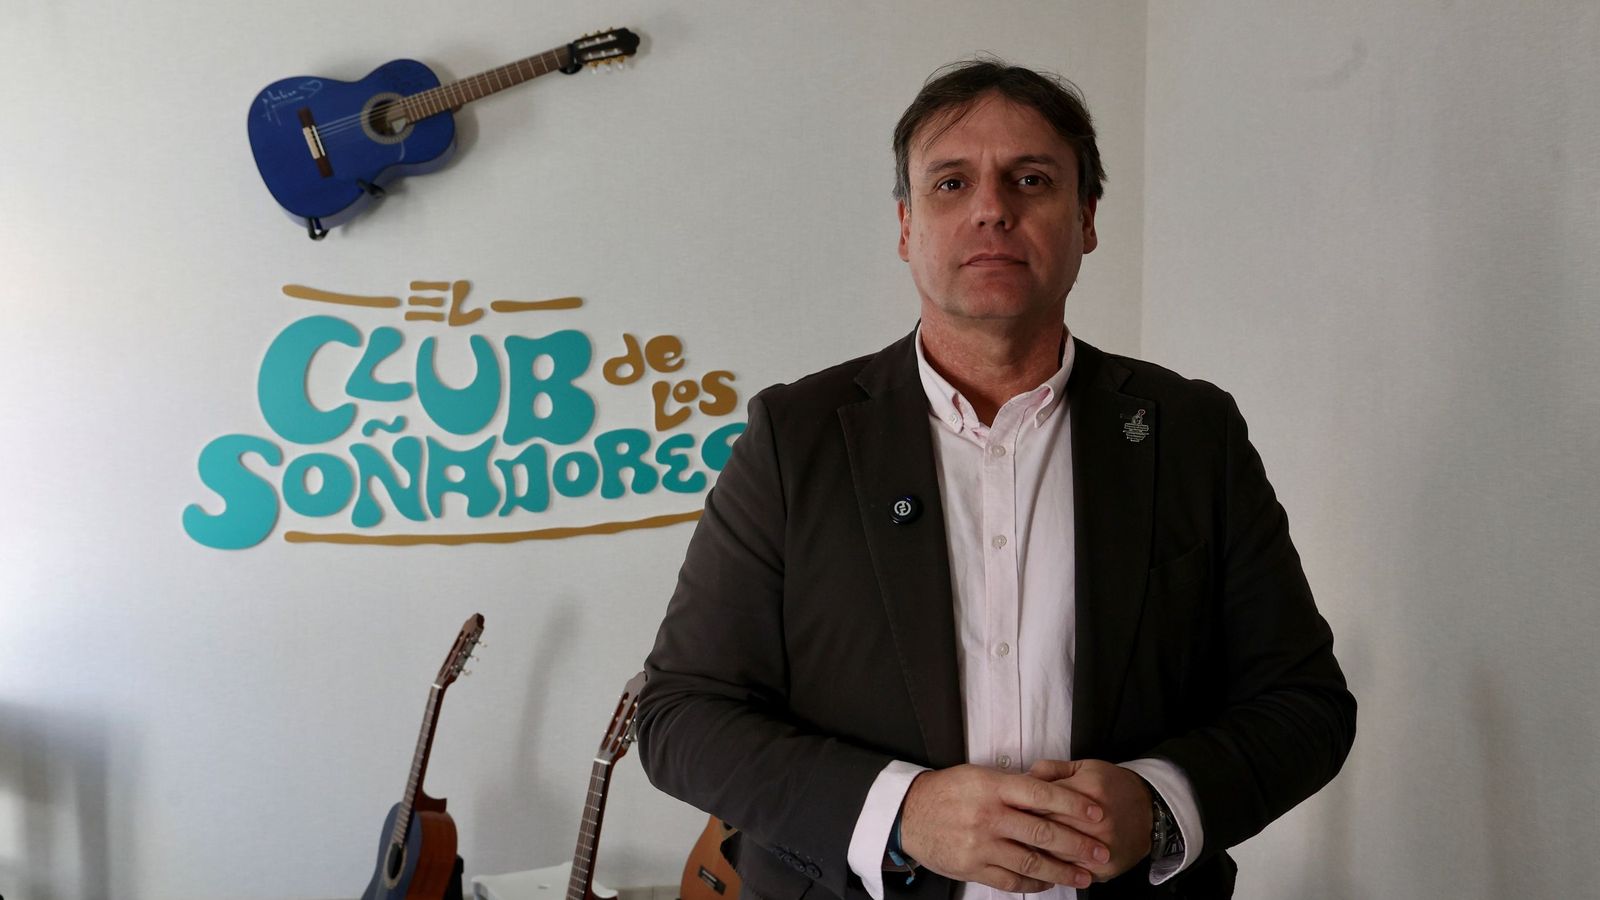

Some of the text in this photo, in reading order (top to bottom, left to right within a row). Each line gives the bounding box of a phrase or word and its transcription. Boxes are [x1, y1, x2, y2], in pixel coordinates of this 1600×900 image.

[405, 280, 484, 326] EL
[258, 315, 685, 445] CLUB de
